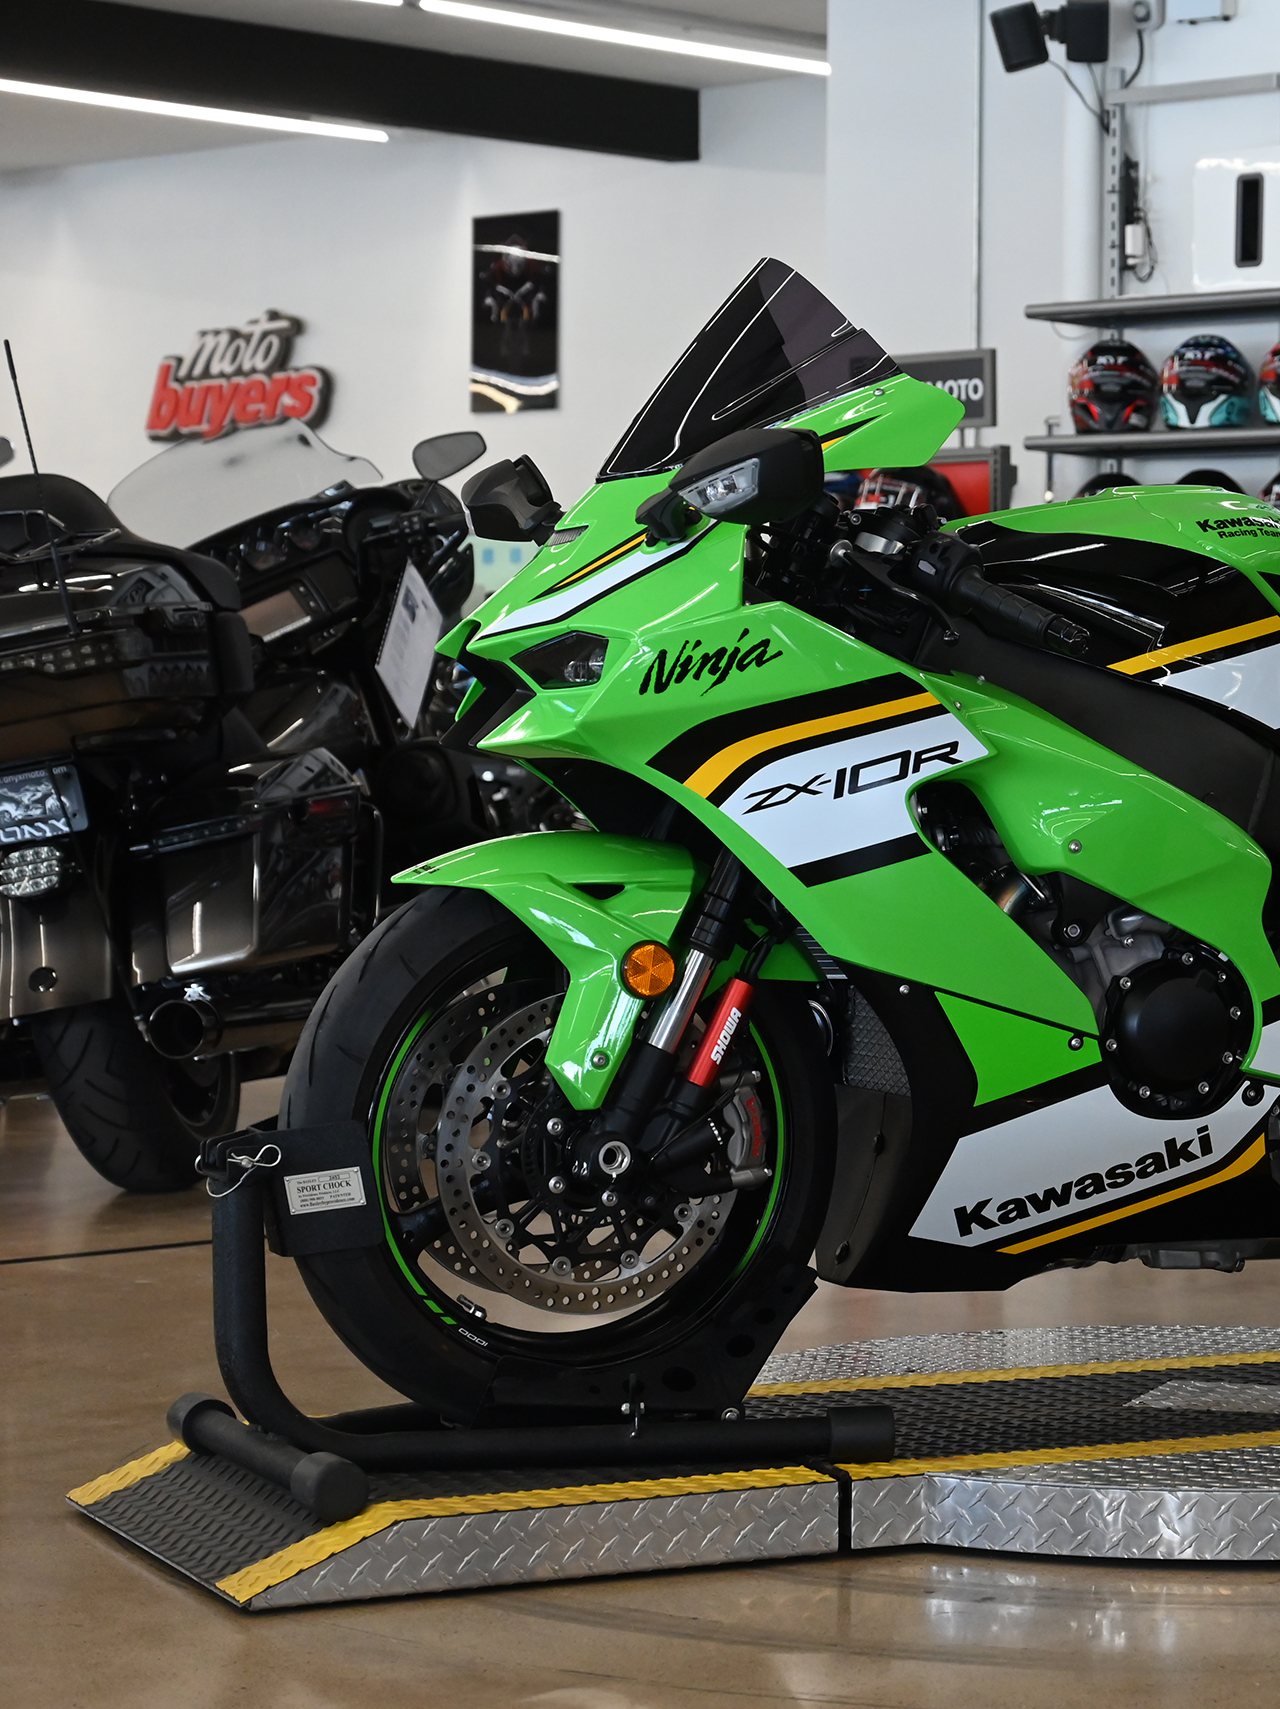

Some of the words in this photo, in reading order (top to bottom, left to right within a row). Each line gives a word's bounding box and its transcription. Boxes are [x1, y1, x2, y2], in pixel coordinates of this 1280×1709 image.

[146, 361, 319, 440] buyers
[1217, 528, 1258, 539] Racing
[638, 627, 783, 697] Ninja
[741, 740, 964, 816] ZX-10R
[710, 1006, 742, 1065] SHOWA
[746, 1096, 764, 1157] brembo
[296, 1183, 322, 1194] SPORT
[322, 1180, 352, 1190] CHOCK
[952, 1124, 1215, 1238] Kawasaki
[458, 1327, 489, 1347] 1000
